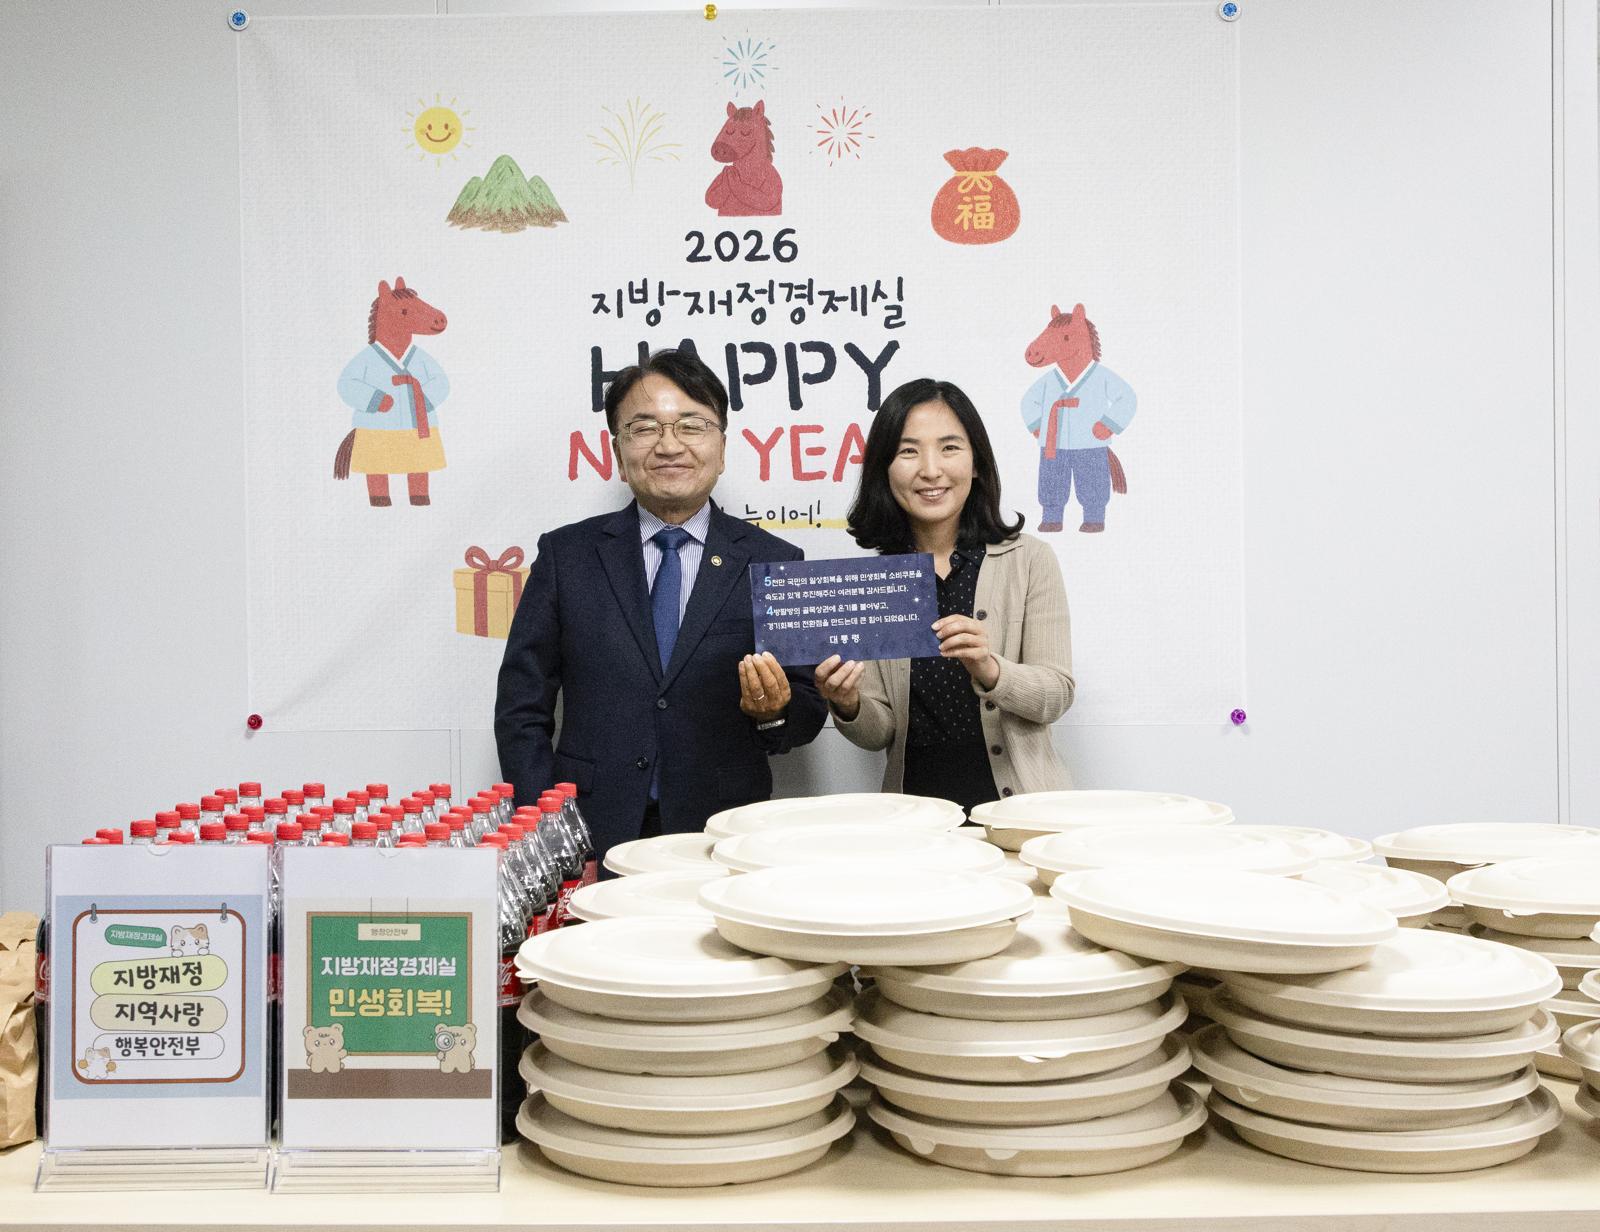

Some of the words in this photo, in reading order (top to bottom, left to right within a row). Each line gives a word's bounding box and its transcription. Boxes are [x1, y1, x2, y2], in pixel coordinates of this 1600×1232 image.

[954, 195, 995, 231] 福
[685, 228, 799, 263] 2026
[591, 276, 906, 329] 지방재정경제실
[591, 338, 900, 412] HPPY
[866, 584, 909, 595] 감사드립니다.
[889, 570, 922, 580] 소비쿠폰을
[113, 961, 204, 990] 지방재정
[321, 956, 457, 977] 지방재정경제실
[114, 1001, 204, 1028] 지역사랑
[328, 987, 452, 1018] 민생회복!
[115, 1036, 201, 1058] 행복안전부
